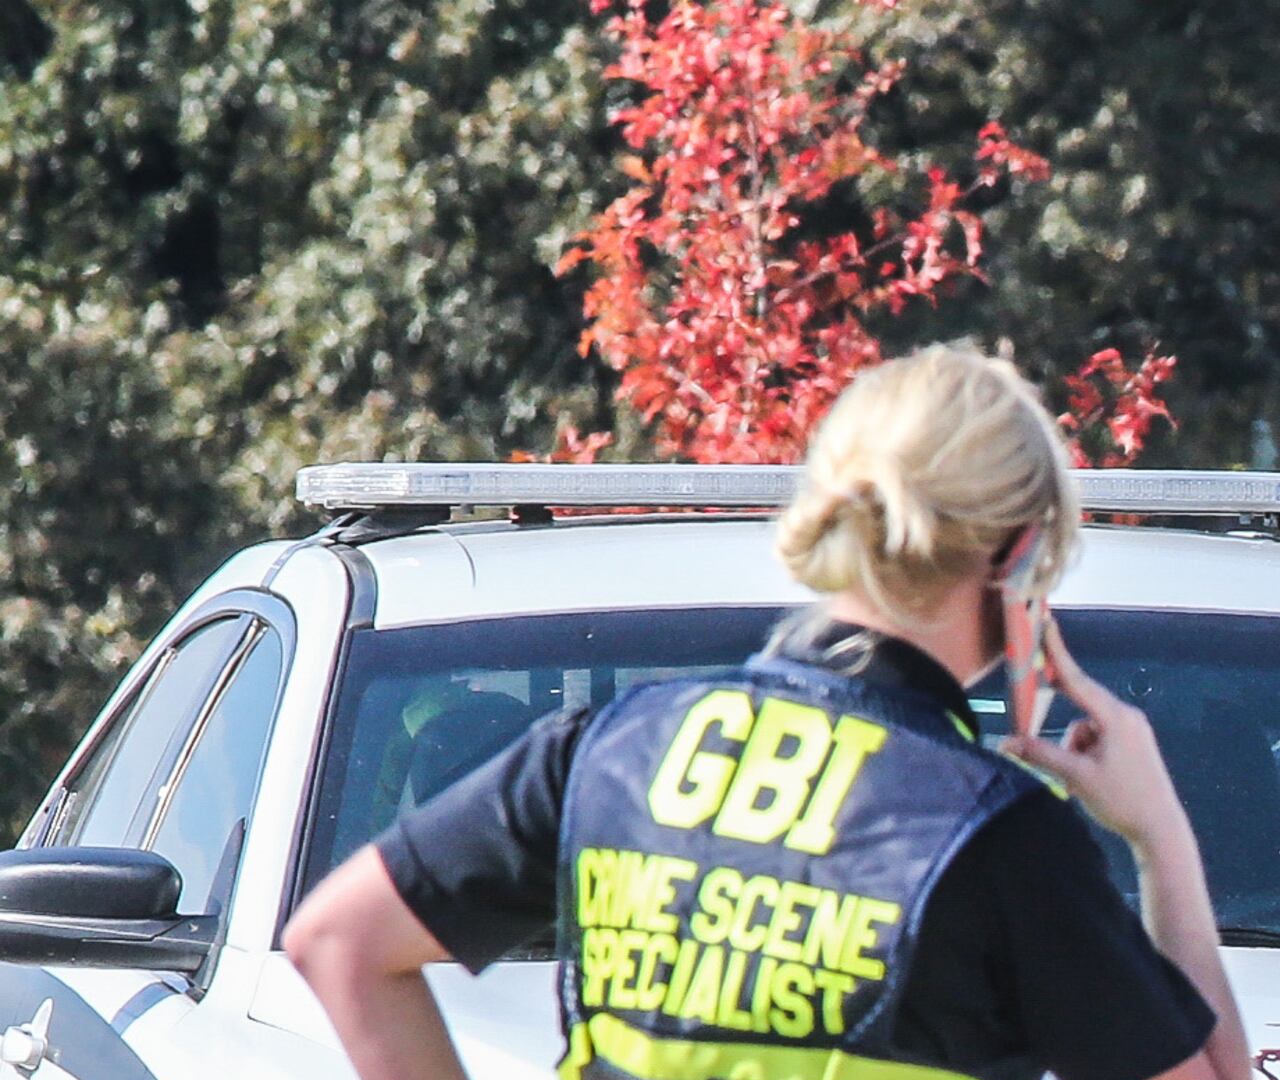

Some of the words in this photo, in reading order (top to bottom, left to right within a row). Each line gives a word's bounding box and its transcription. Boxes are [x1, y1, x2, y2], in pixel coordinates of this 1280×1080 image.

[648, 689, 889, 856] GBI
[577, 848, 698, 934] CRIME
[690, 866, 901, 980] SCENE
[582, 928, 857, 1038] SPECIALIST
